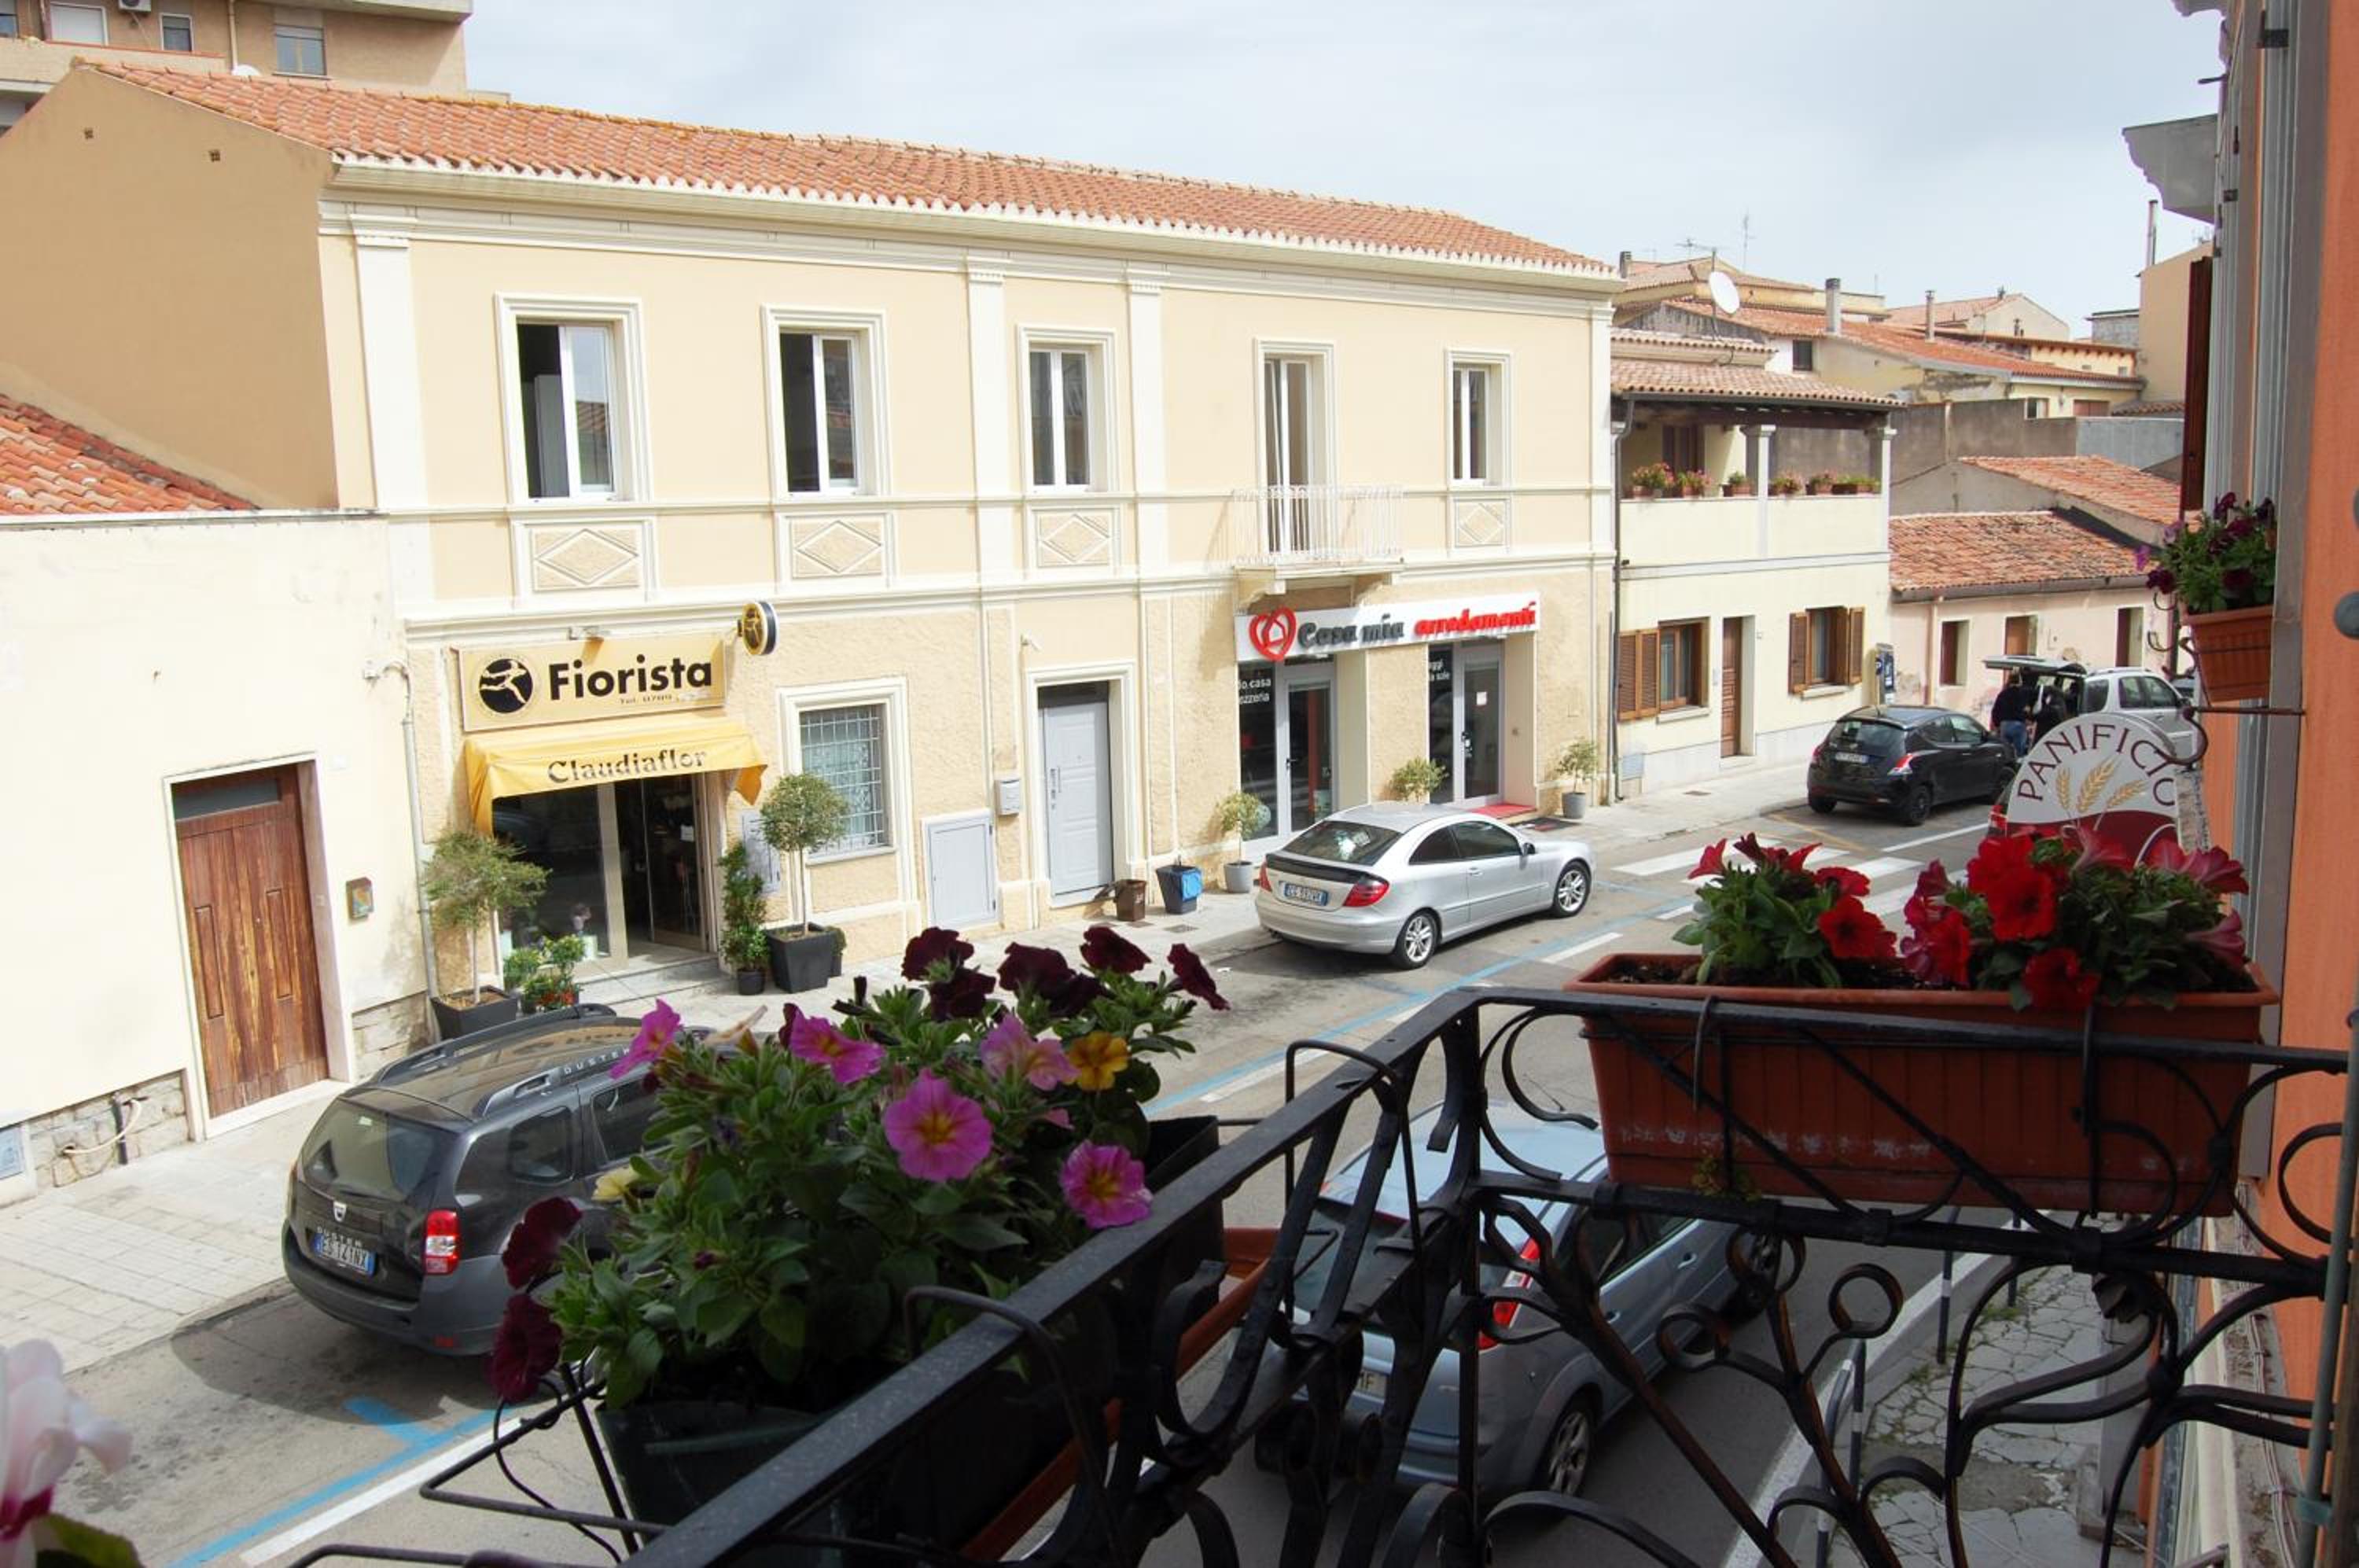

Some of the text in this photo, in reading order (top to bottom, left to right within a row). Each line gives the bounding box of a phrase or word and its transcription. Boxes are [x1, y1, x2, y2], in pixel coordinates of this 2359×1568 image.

[1297, 601, 1536, 648] Casa mia arredamenti
[549, 653, 712, 701] Fiorista
[547, 748, 707, 783] Claudiaflor
[317, 1226, 362, 1248] DUSTER
